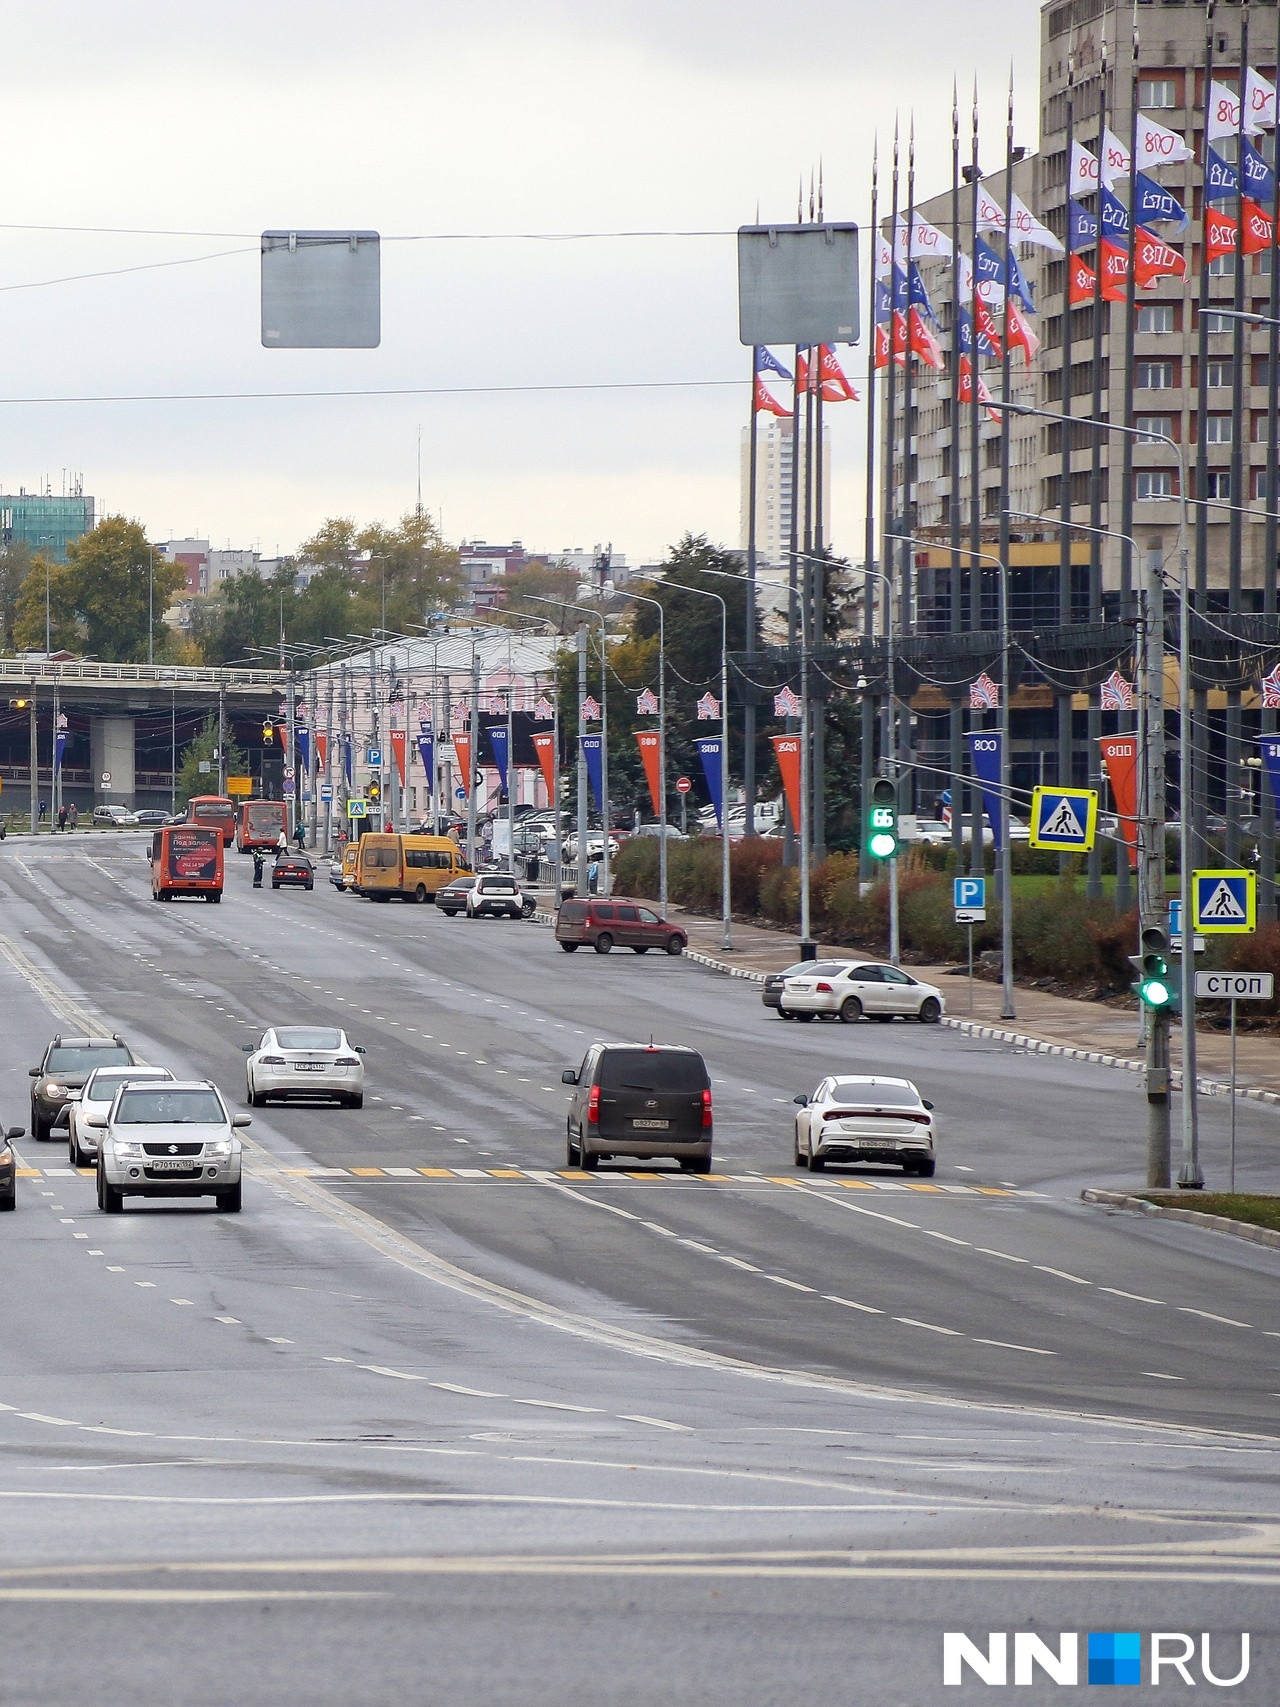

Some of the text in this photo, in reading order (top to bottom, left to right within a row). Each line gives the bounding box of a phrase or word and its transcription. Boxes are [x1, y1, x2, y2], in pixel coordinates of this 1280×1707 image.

[1145, 132, 1175, 155] 800
[1142, 243, 1177, 267] 800
[584, 740, 600, 748] 800
[641, 737, 657, 746] 800
[701, 744, 719, 753] 800
[974, 739, 997, 751] 800
[1107, 745, 1131, 757] 800
[874, 809, 894, 827] 66
[961, 882, 978, 904] P
[1207, 978, 1261, 994] СТОП
